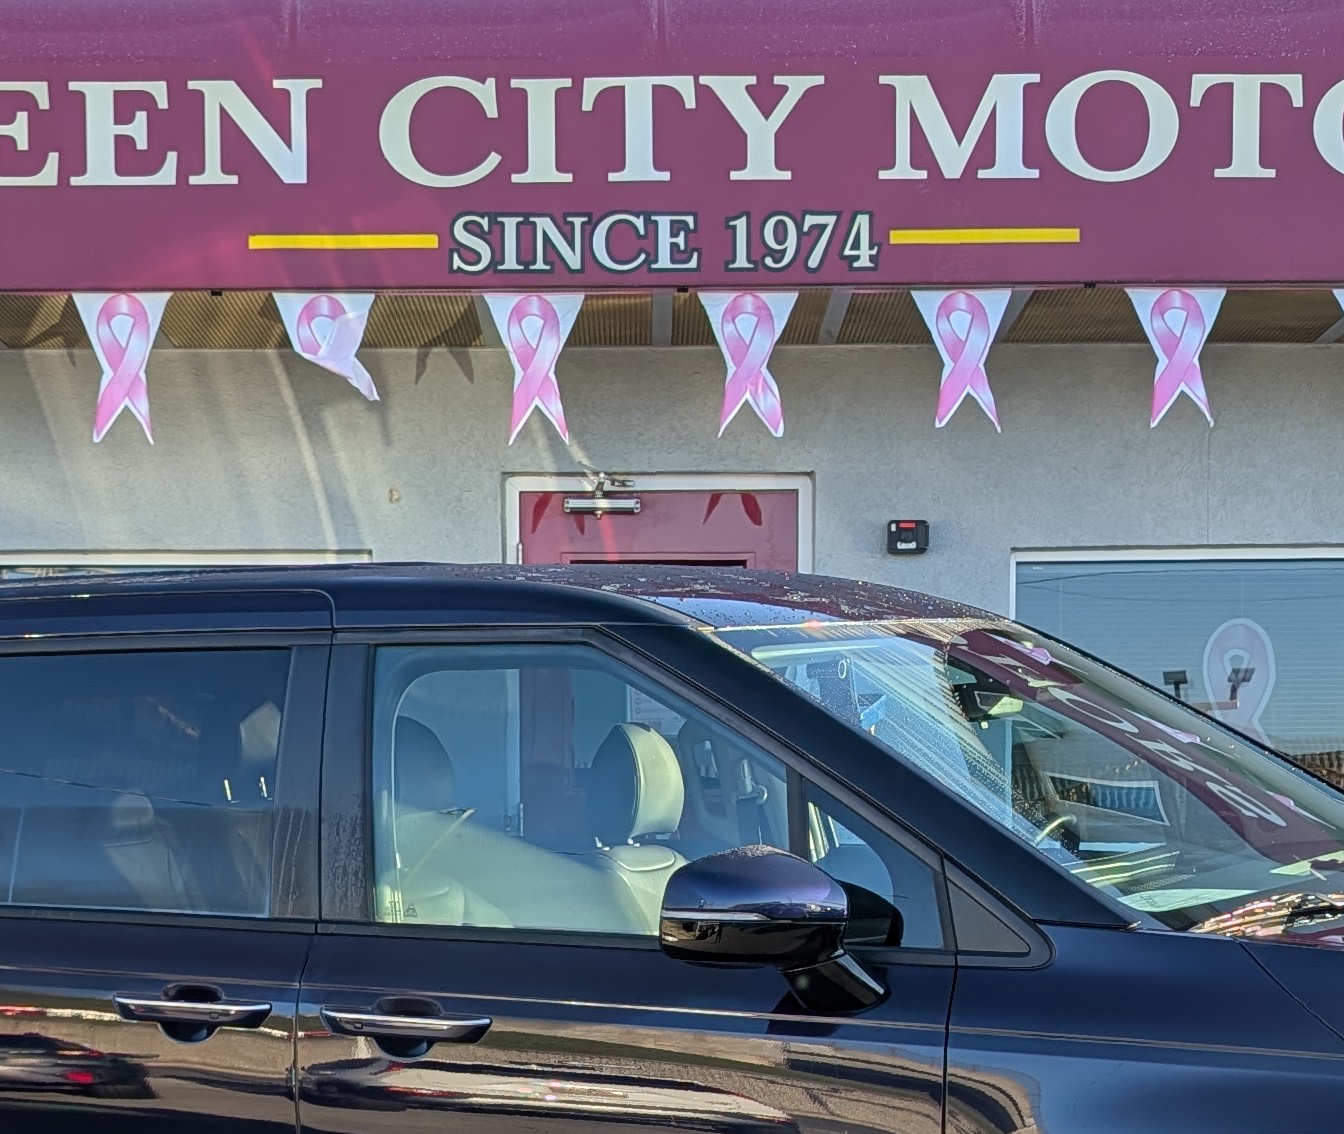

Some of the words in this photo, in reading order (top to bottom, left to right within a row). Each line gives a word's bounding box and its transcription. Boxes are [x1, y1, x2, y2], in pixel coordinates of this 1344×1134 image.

[379, 75, 825, 188] CITY
[449, 211, 700, 274] SINCE
[726, 210, 880, 272] 1974
